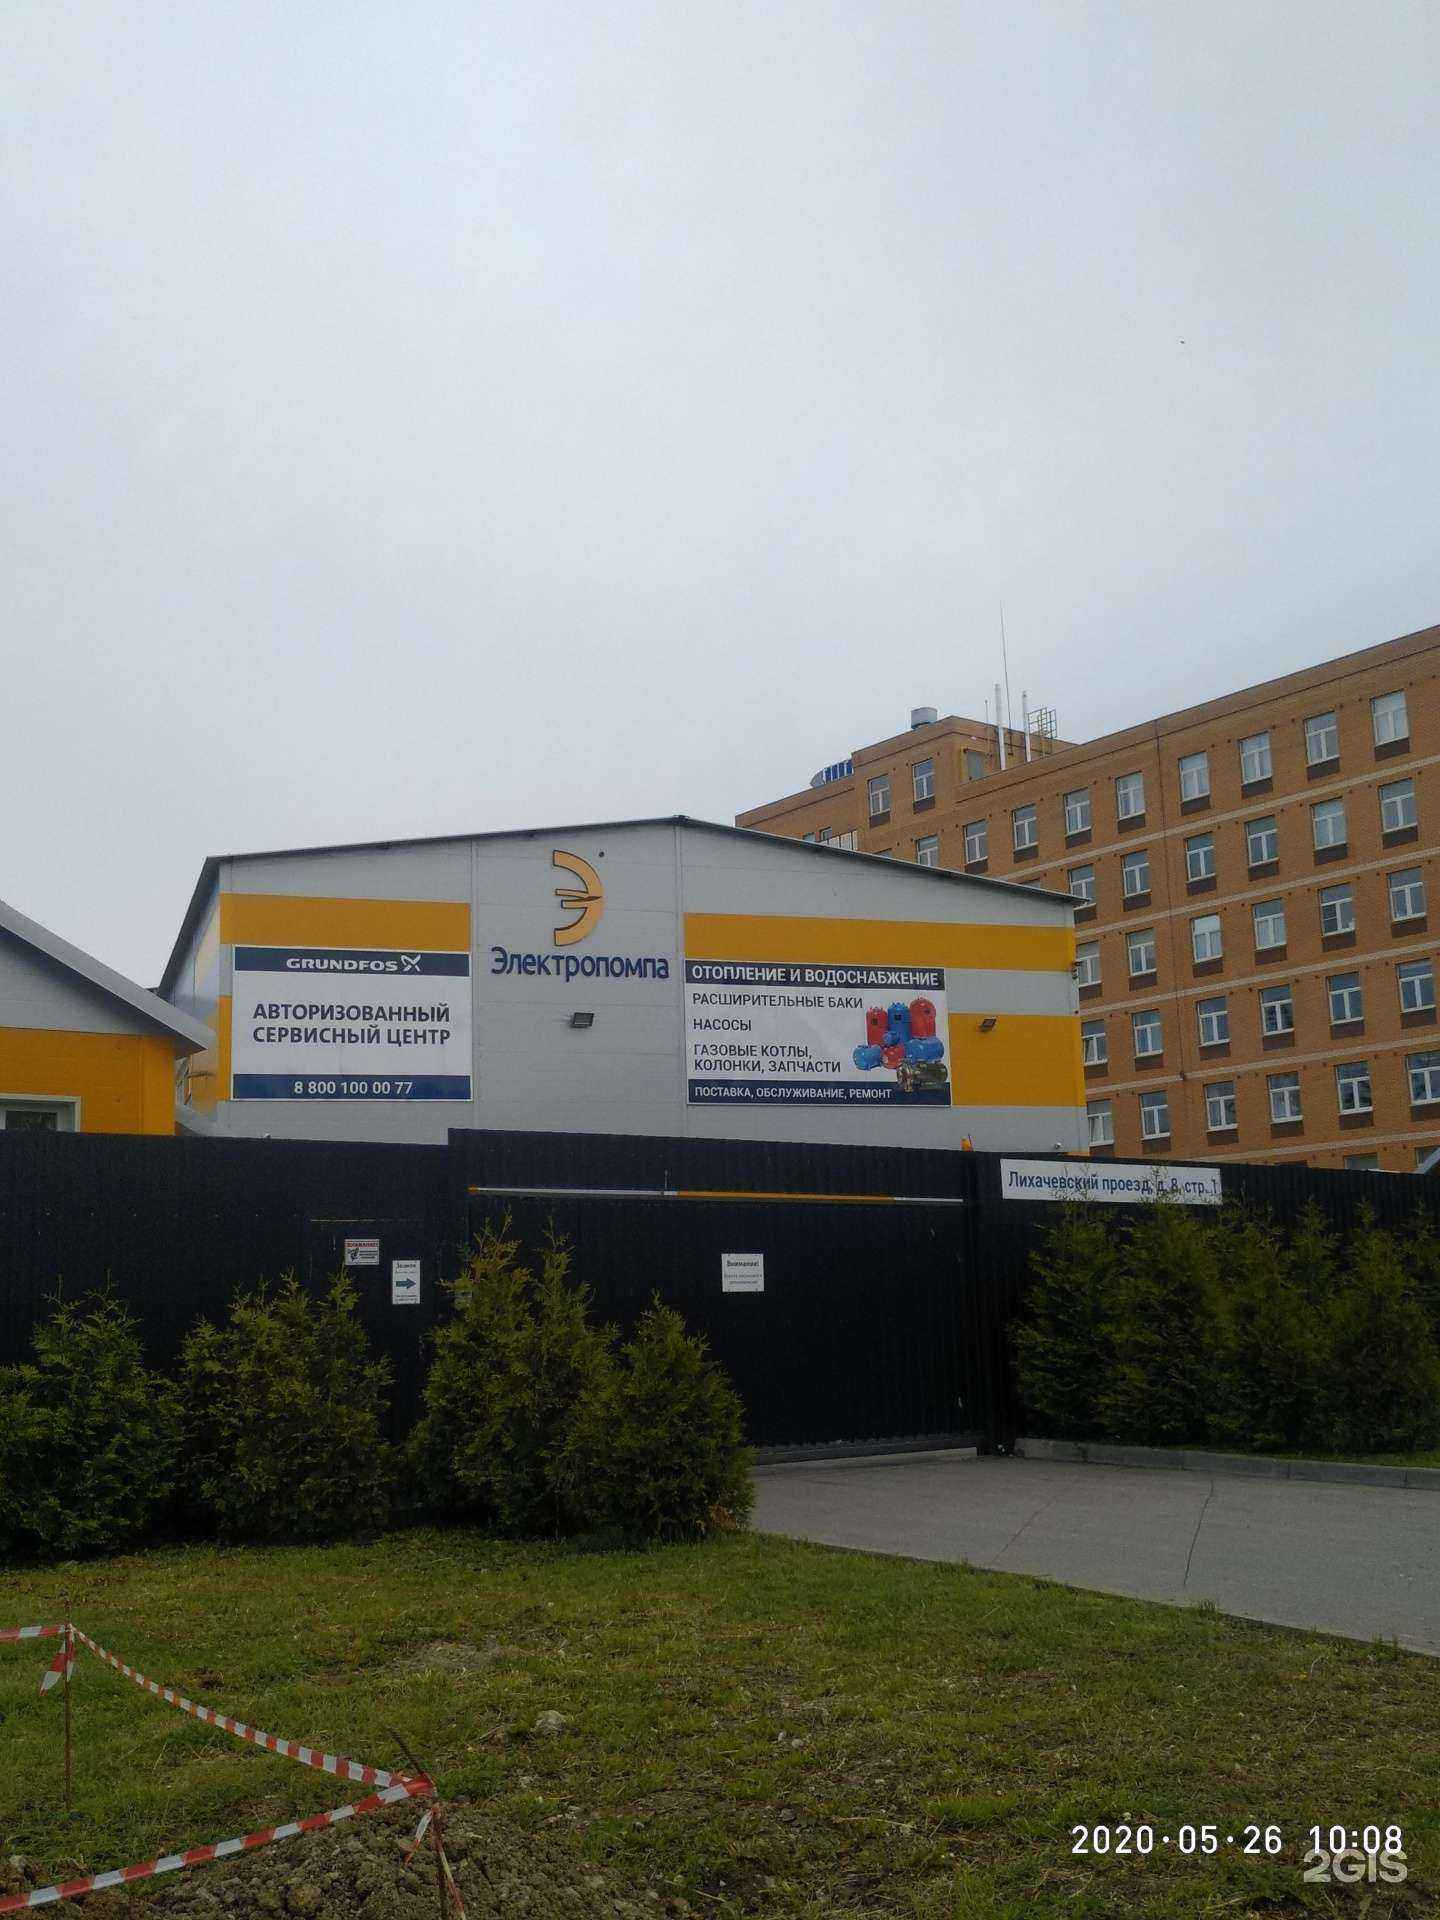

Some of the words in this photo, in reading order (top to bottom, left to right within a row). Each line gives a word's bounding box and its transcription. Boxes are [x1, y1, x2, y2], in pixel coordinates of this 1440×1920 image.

[286, 958, 398, 971] GRUNDFOS
[491, 947, 669, 982] Электропомпа
[692, 965, 786, 981] ОТОПЛЕНИЕ
[790, 968, 801, 981] И
[805, 969, 938, 986] ВОДОСНАБЖЕНИЕ
[692, 993, 824, 1007] РАСШИРИТЕЛЬНЫЕ
[827, 997, 863, 1009] БАКИ
[253, 1002, 450, 1023] АВТОРИЗОВАННЫЙ
[693, 1019, 752, 1032] НАСОСЫ
[253, 1025, 381, 1044] СЕРВИСНЫЙ
[388, 1029, 450, 1047] ЦЕНТР
[694, 1044, 757, 1057] ГАЗОВЫЕ
[761, 1045, 812, 1059] КОТЛЫ,
[694, 1060, 765, 1073] КОЛОНКИ,
[768, 1060, 841, 1073] ЗАПЧАСТИ
[294, 1082, 302, 1094] 8
[307, 1082, 335, 1094] 800
[342, 1082, 367, 1094] 100
[372, 1082, 390, 1094] 00
[394, 1082, 413, 1094] 77
[695, 1087, 754, 1098] ПОСТАВКА,
[757, 1088, 847, 1099] ОБСЛУЖИВАНИЕ,
[850, 1089, 892, 1099] РЕМОНТ
[1008, 1171, 1099, 1191] Лихачевский
